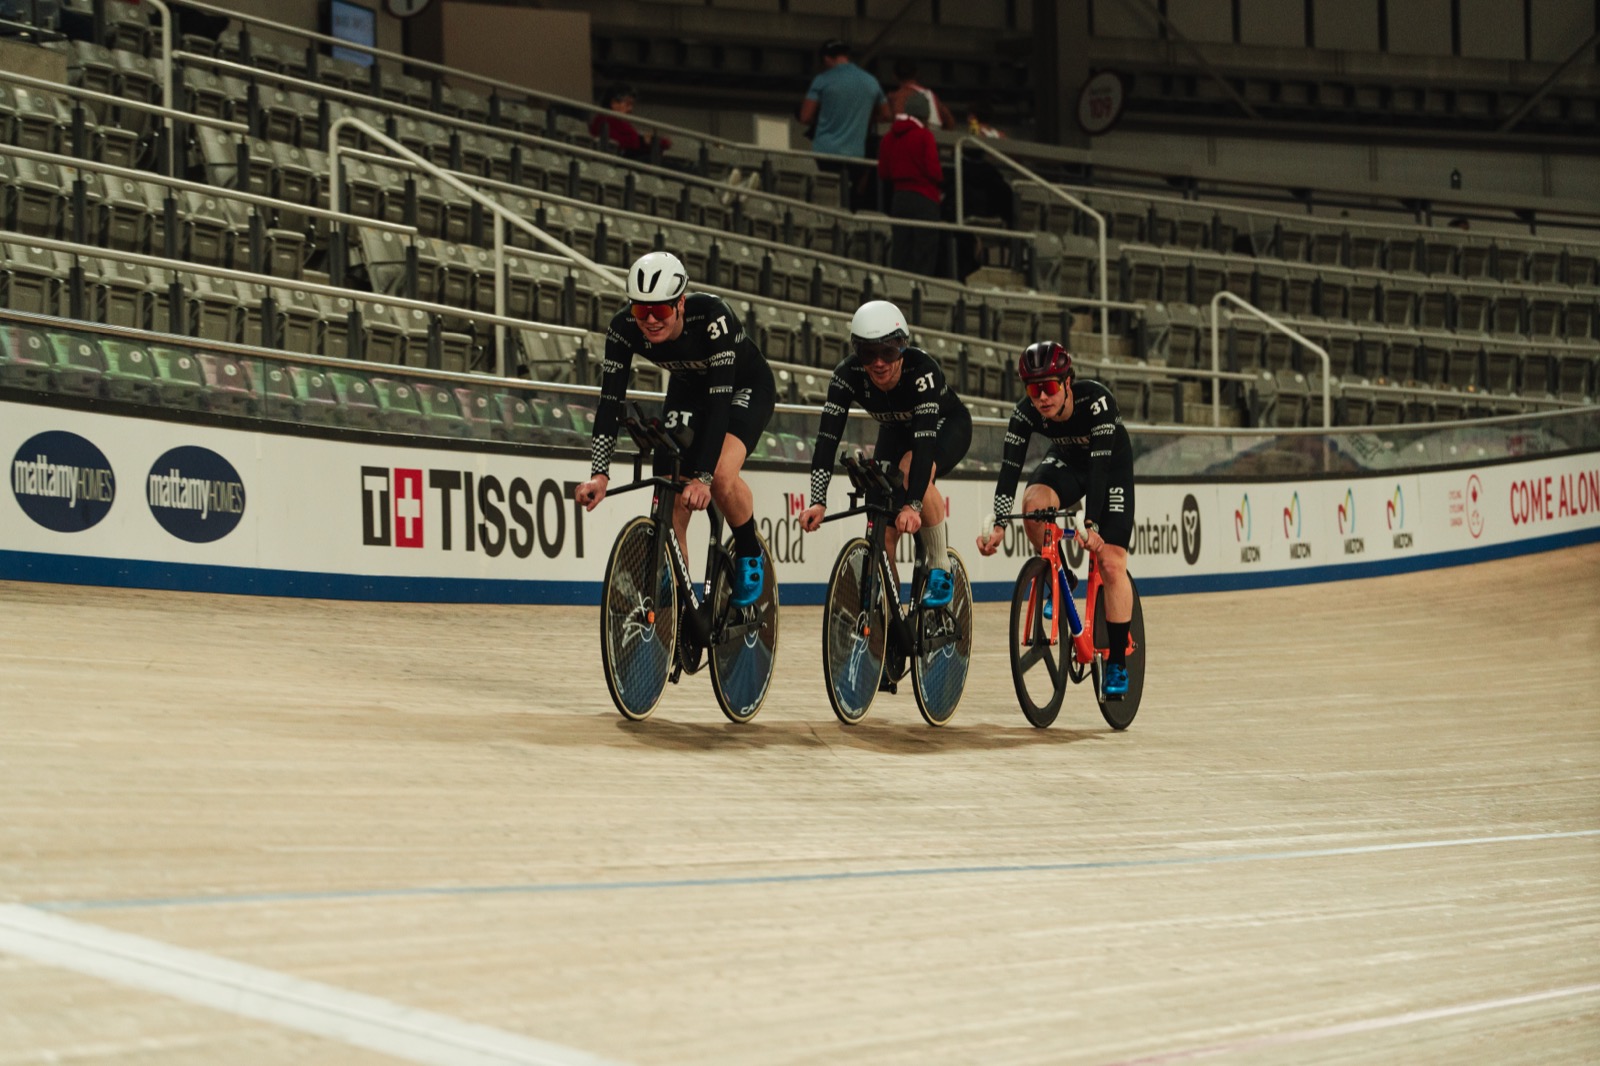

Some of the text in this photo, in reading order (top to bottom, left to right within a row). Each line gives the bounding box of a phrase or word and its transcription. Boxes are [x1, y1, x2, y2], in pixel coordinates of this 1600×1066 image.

[707, 315, 729, 340] 3T
[915, 372, 935, 392] 3T
[1090, 395, 1109, 416] 3T
[664, 411, 693, 429] 3T
[1109, 487, 1125, 512] HUS
[1510, 476, 1553, 526] COME
[429, 468, 584, 559] TISSOT
